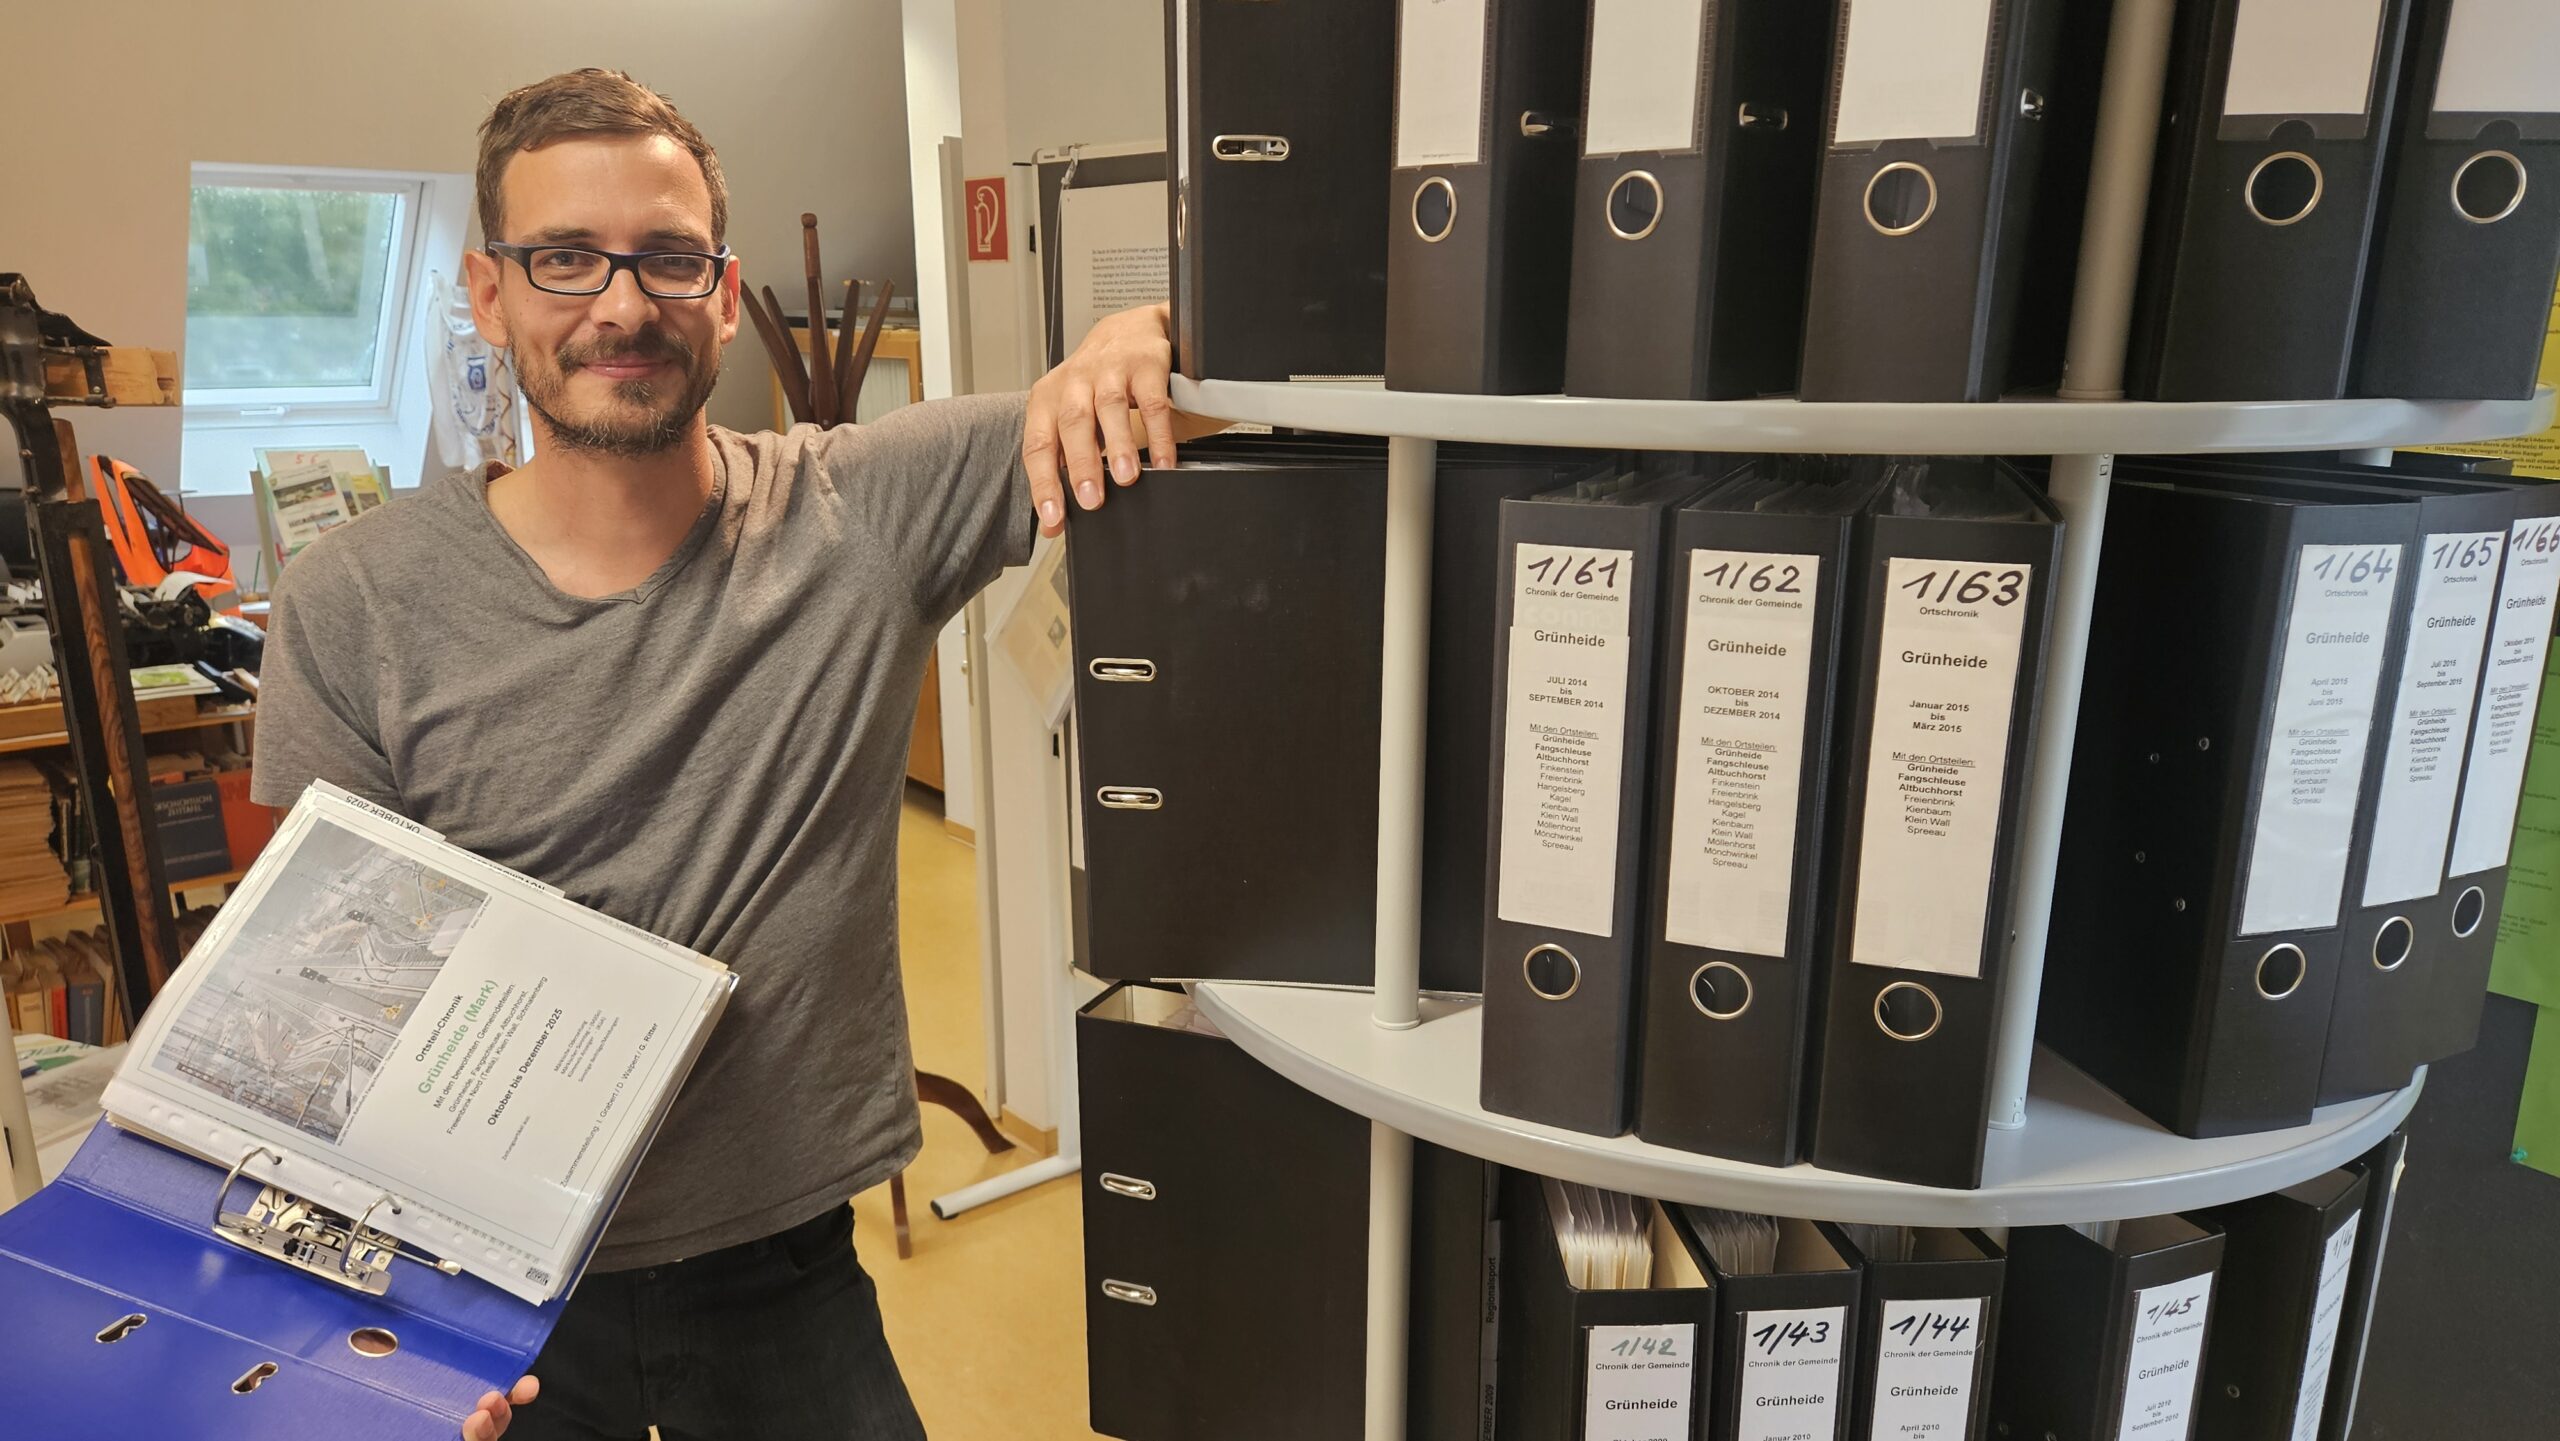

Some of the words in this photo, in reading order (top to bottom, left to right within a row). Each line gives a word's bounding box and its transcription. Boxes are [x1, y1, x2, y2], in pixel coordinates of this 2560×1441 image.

[2433, 537, 2500, 569] 1/65
[1528, 555, 1618, 588] 1/61
[2314, 548, 2393, 584] 1/64
[1704, 562, 1800, 593] 1/62
[1902, 569, 2024, 606] 1/63
[1525, 587, 1557, 597] Chronik
[1576, 592, 1619, 602] Gemeinde
[1700, 595, 1735, 604] Chronik
[1755, 599, 1802, 609] Gemeinde
[2507, 596, 2546, 609] Grünheide
[1920, 607, 1979, 618] Ortschronik
[2427, 616, 2476, 628] Grünheide
[1534, 630, 1605, 647] Grünheide
[2306, 632, 2369, 644] Grünheide
[1708, 639, 1787, 656] Grünheide
[1902, 651, 1988, 668] Grünheide
[1547, 677, 1565, 685] JULI
[1568, 678, 1587, 687] 2014
[2311, 678, 2329, 686] April
[2416, 680, 2448, 688] September
[1708, 686, 1755, 697] OKTOBER
[1758, 691, 1779, 699] 2014
[1529, 694, 1581, 706] SEPTEMBER
[1584, 700, 1603, 708] 2014
[1736, 699, 1749, 707] bis
[1909, 700, 1943, 710] Januar
[1946, 703, 1969, 712] 2015
[1704, 706, 1756, 718] DEZEMBER
[1759, 711, 1780, 720] 2014
[1530, 723, 1541, 731] Mit
[1543, 725, 1557, 733] den
[1913, 722, 1936, 731] März
[1938, 724, 1962, 732] 2015
[1542, 734, 1585, 746] Grünheide
[1701, 737, 1713, 745] Mit
[1716, 739, 1731, 747] den
[1535, 743, 1591, 756] Fangschleuse
[1715, 748, 1761, 760] Grünheide
[1536, 753, 1589, 766] Altbuchhorst
[1892, 752, 1906, 760] Mit
[1909, 754, 1925, 762] den
[1540, 763, 1584, 775] Finkenstein
[1707, 758, 1769, 770] Fangschleuse
[1908, 764, 1958, 775] Grünheide
[1540, 773, 1582, 784] Freienbrink
[1708, 768, 1766, 780] Altbuchhorst
[1898, 773, 1966, 786] Fangschleuse
[1537, 782, 1585, 796] Hangelsberg
[1712, 778, 1760, 790] Finkenstein
[1899, 784, 1962, 796] Altbuchhorst
[1550, 793, 1571, 803] Kagel
[1712, 788, 1758, 800] Freienbrink
[346, 796, 369, 810] 2025
[1708, 799, 1761, 812] Hangelsberg
[1904, 795, 1955, 806] Freienbrink
[1542, 802, 1578, 813] Kienbaum
[1906, 805, 1951, 816] Kienbaum
[1722, 809, 1746, 819] Kagel
[1713, 818, 1754, 830] Kienbaum
[1905, 816, 1927, 824] Klein
[1930, 818, 1950, 826] Wall
[1712, 828, 1732, 837] Klein
[1735, 831, 1753, 839] Wall
[1908, 826, 1946, 836] Spreeau
[416, 995, 462, 1061] Ortsteil-Chronik
[644, 1023, 657, 1041] Ritter
[418, 1025, 468, 1093] Grünheide
[464, 980, 498, 1022] (Mark)
[469, 1080, 483, 1096] Nord
[495, 1039, 509, 1054] Klein
[488, 1090, 513, 1125] Oktober
[510, 1075, 522, 1088] bis
[519, 1030, 549, 1073] Dezember
[546, 1008, 562, 1029] 2025
[433, 1096, 445, 1108] Mit
[443, 1081, 454, 1095] den
[451, 1040, 480, 1080] bewohnten
[1486, 1257, 1496, 1323] Regionalsport
[2147, 1295, 2200, 1325] 1/45
[1890, 1312, 1969, 1346] 1/44
[2136, 1332, 2159, 1344] Chronik
[2161, 1330, 2171, 1338] der
[2173, 1321, 2203, 1335] Gemeinde
[1753, 1321, 1829, 1355] 1/43
[1611, 1337, 1676, 1356] 1/42
[1933, 1349, 1972, 1357] Gemeinde
[1648, 1361, 1690, 1369] Gemeinde
[1749, 1360, 1780, 1368] Chronik
[1798, 1357, 1838, 1366] Gemeinde
[2138, 1359, 2189, 1380] Grünheide
[1890, 1385, 1958, 1397] Grünheide
[1606, 1399, 1678, 1411] Grünheide
[1756, 1395, 1824, 1407] Grünheide
[2158, 1400, 2171, 1408] 2010
[1901, 1424, 1919, 1432] April
[2132, 1418, 2164, 1431] September
[2165, 1413, 2179, 1422] 2010
